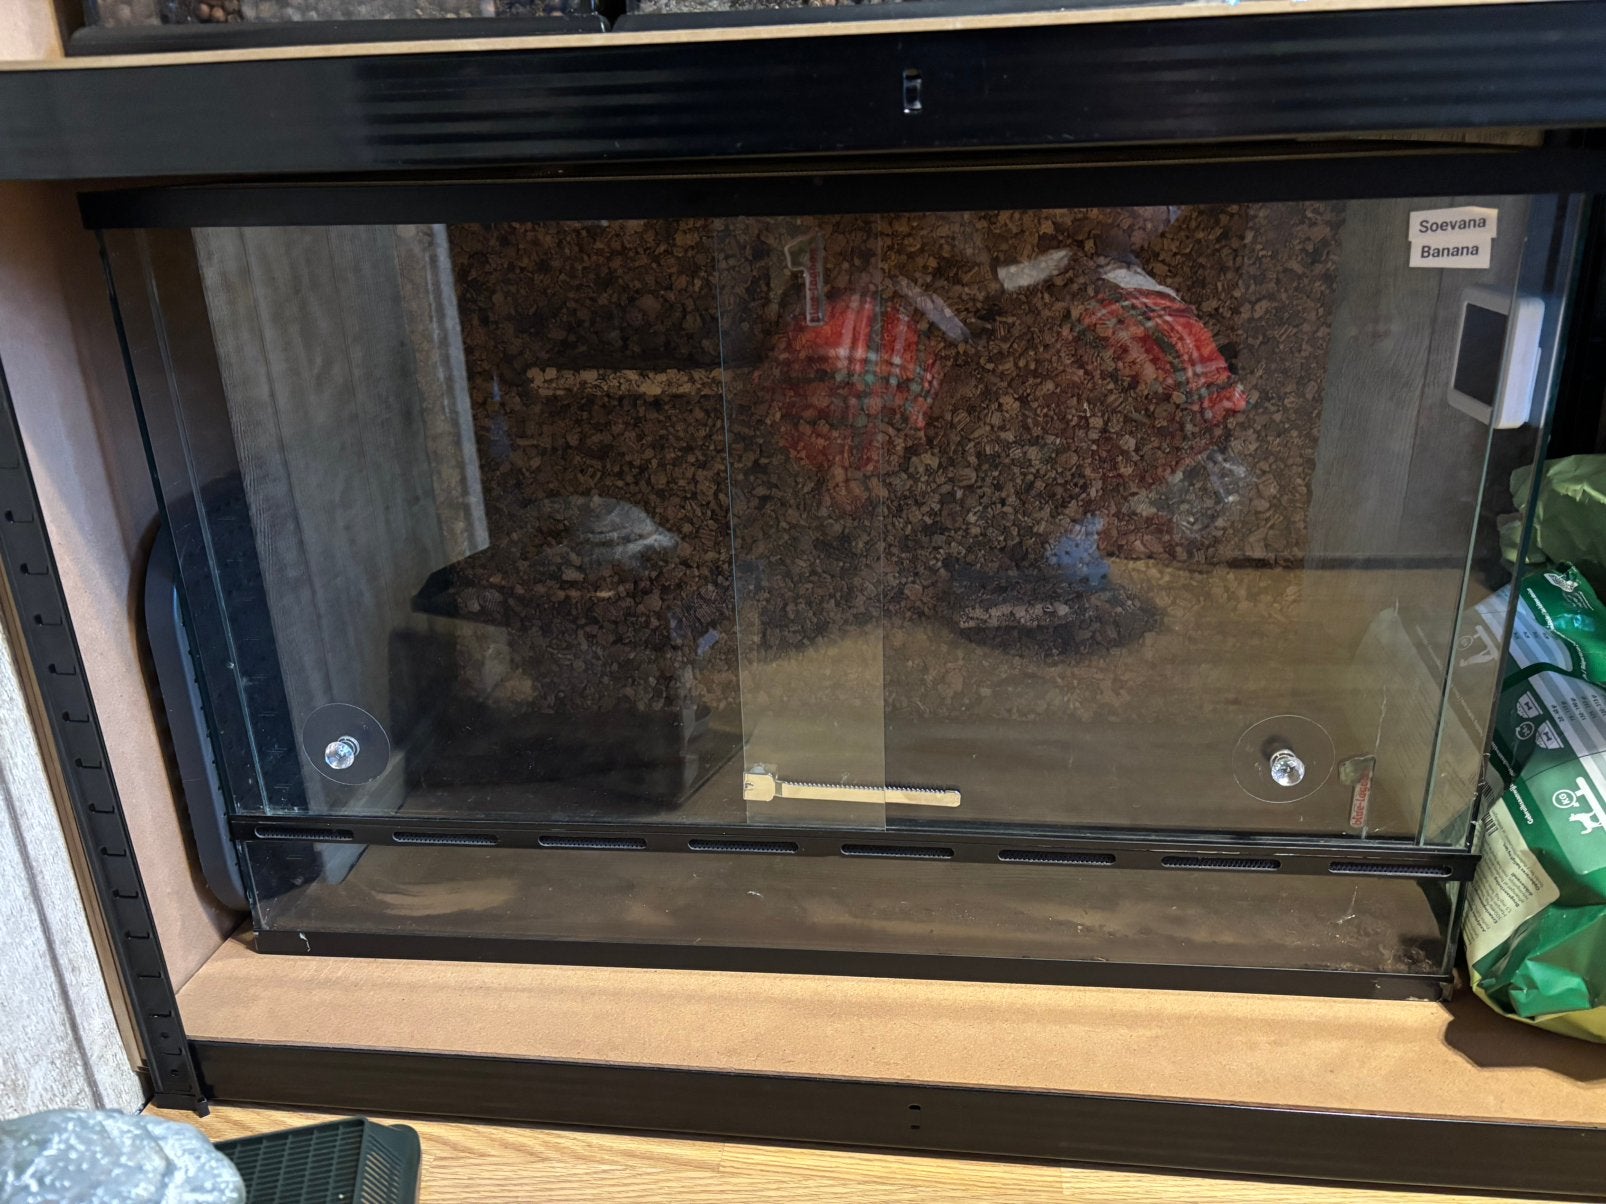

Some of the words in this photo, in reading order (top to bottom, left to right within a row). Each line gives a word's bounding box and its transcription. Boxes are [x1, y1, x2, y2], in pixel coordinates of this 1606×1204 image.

[1418, 217, 1487, 233] Soevana
[1420, 245, 1480, 258] Banana
[1558, 793, 1570, 805] KG
